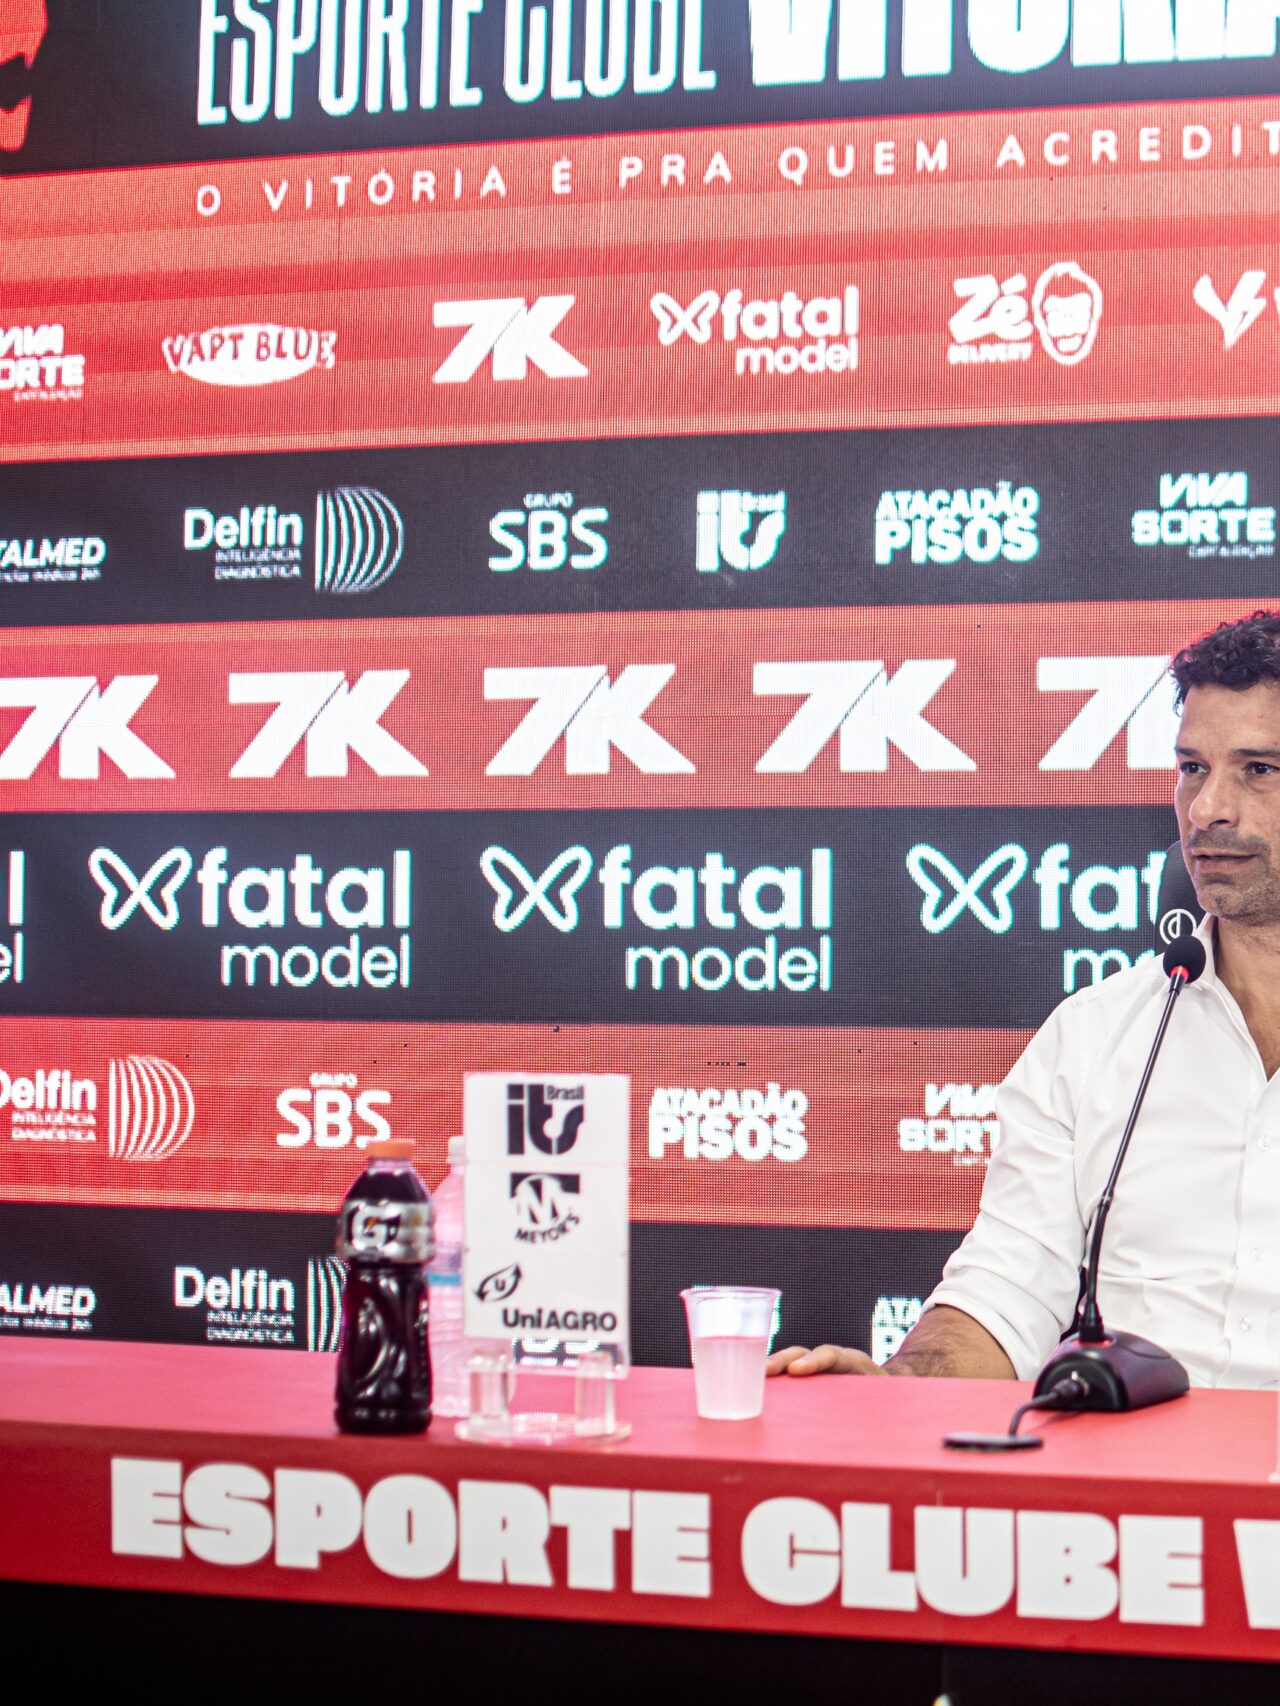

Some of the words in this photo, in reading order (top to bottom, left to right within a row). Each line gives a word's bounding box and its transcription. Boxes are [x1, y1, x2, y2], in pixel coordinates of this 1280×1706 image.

[196, 184, 222, 217] O
[262, 164, 508, 212] VITÓRIA
[551, 155, 573, 195] É
[618, 150, 733, 189] PRA
[777, 136, 949, 186] QUEM
[722, 285, 860, 341] fatal
[948, 272, 1035, 345] Zé
[162, 332, 245, 374] VAPT
[431, 293, 590, 384] 7K
[735, 338, 860, 376] model
[0, 353, 86, 390] ORTE
[874, 480, 1040, 519] ATACADÃO
[1160, 471, 1248, 509] VIVA
[184, 504, 304, 550] Delfin
[487, 506, 610, 573] SBS
[875, 516, 1040, 565] PISOS
[1131, 507, 1275, 544] SORTE
[0, 536, 107, 568] ALMED
[0, 674, 177, 780] 7K
[227, 668, 430, 779] 7K
[482, 662, 697, 777] 7K
[752, 657, 978, 774] 7K
[197, 847, 411, 928] fatal
[598, 845, 830, 930] fatal
[1033, 842, 1168, 931] fat
[222, 934, 409, 988] model
[625, 936, 830, 991] model
[546, 1084, 585, 1101] Brasil
[650, 1080, 809, 1118] ATACADÃO
[276, 1087, 392, 1150] SBS
[648, 1112, 809, 1162] PISOS
[899, 1118, 1001, 1152] SORT
[0, 1283, 97, 1317] ALMED
[174, 1265, 296, 1312] Delfin
[502, 1307, 618, 1332] UniAGRO
[112, 1458, 710, 1597] ESPORTE
[742, 1498, 1204, 1626] CLUBE
